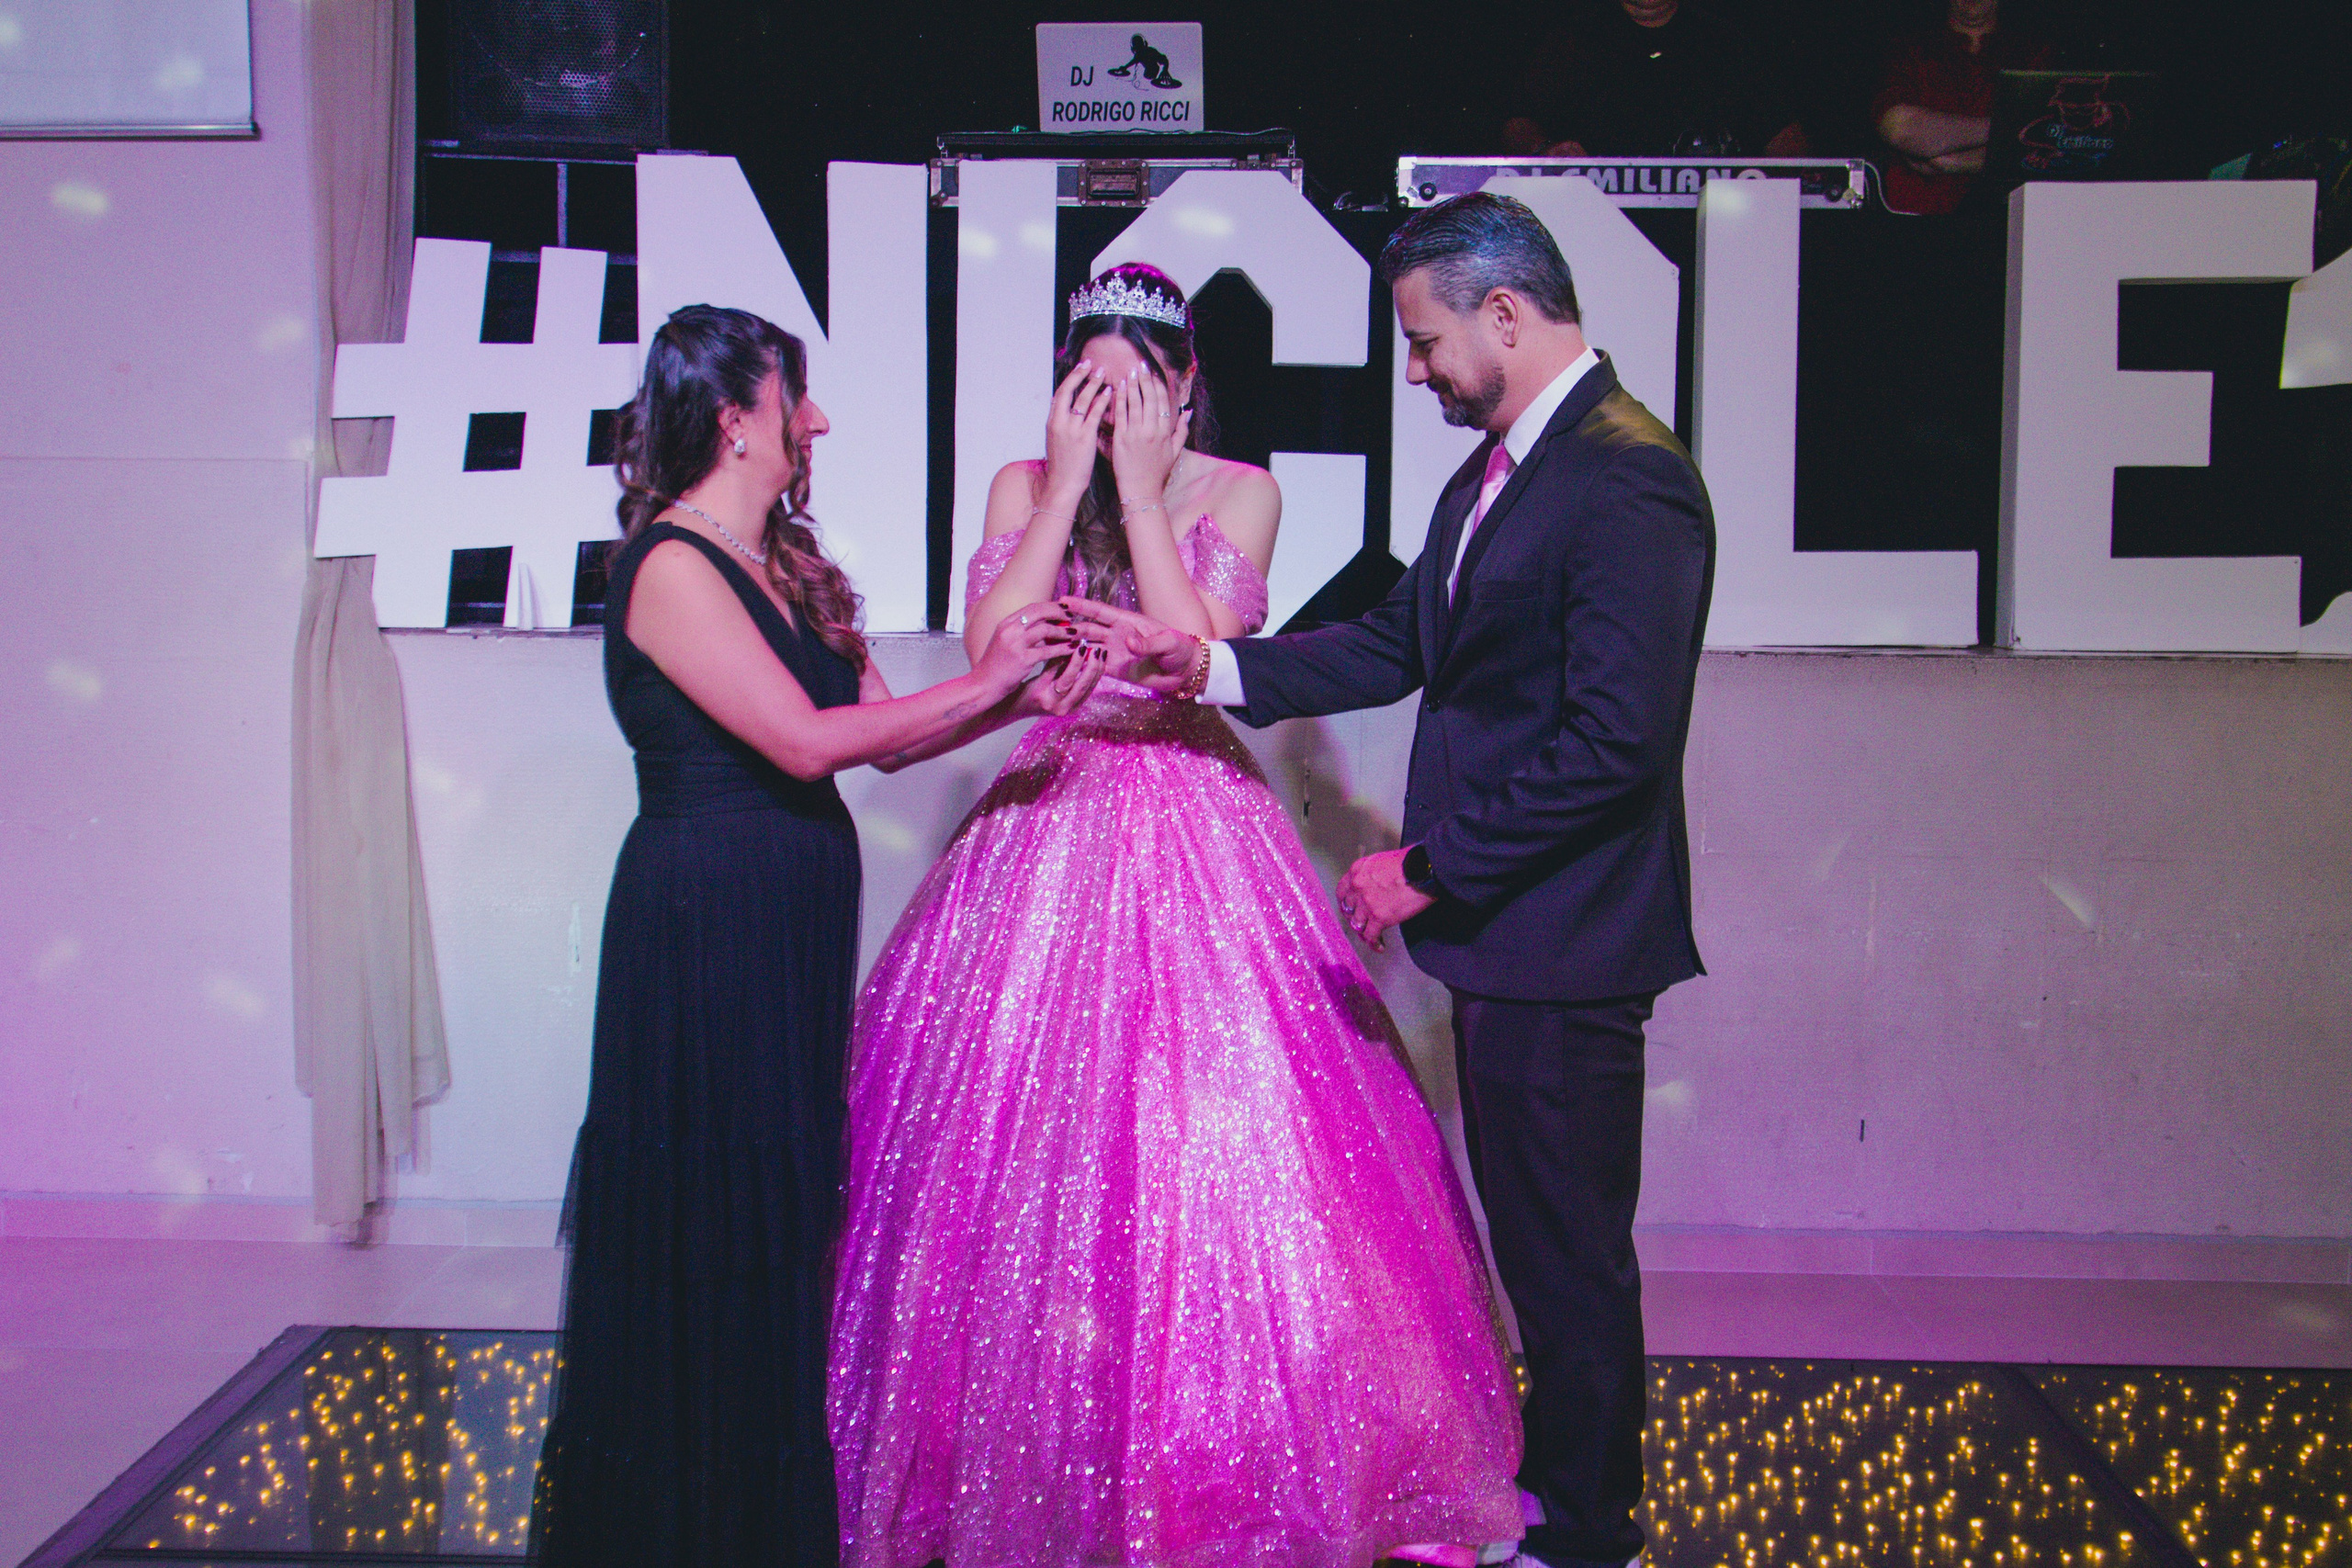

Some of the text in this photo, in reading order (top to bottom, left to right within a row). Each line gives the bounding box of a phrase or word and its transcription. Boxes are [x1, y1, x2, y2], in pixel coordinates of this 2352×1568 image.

[1070, 65, 1094, 87] DJ
[1052, 100, 1191, 122] RODRIGO RICCI
